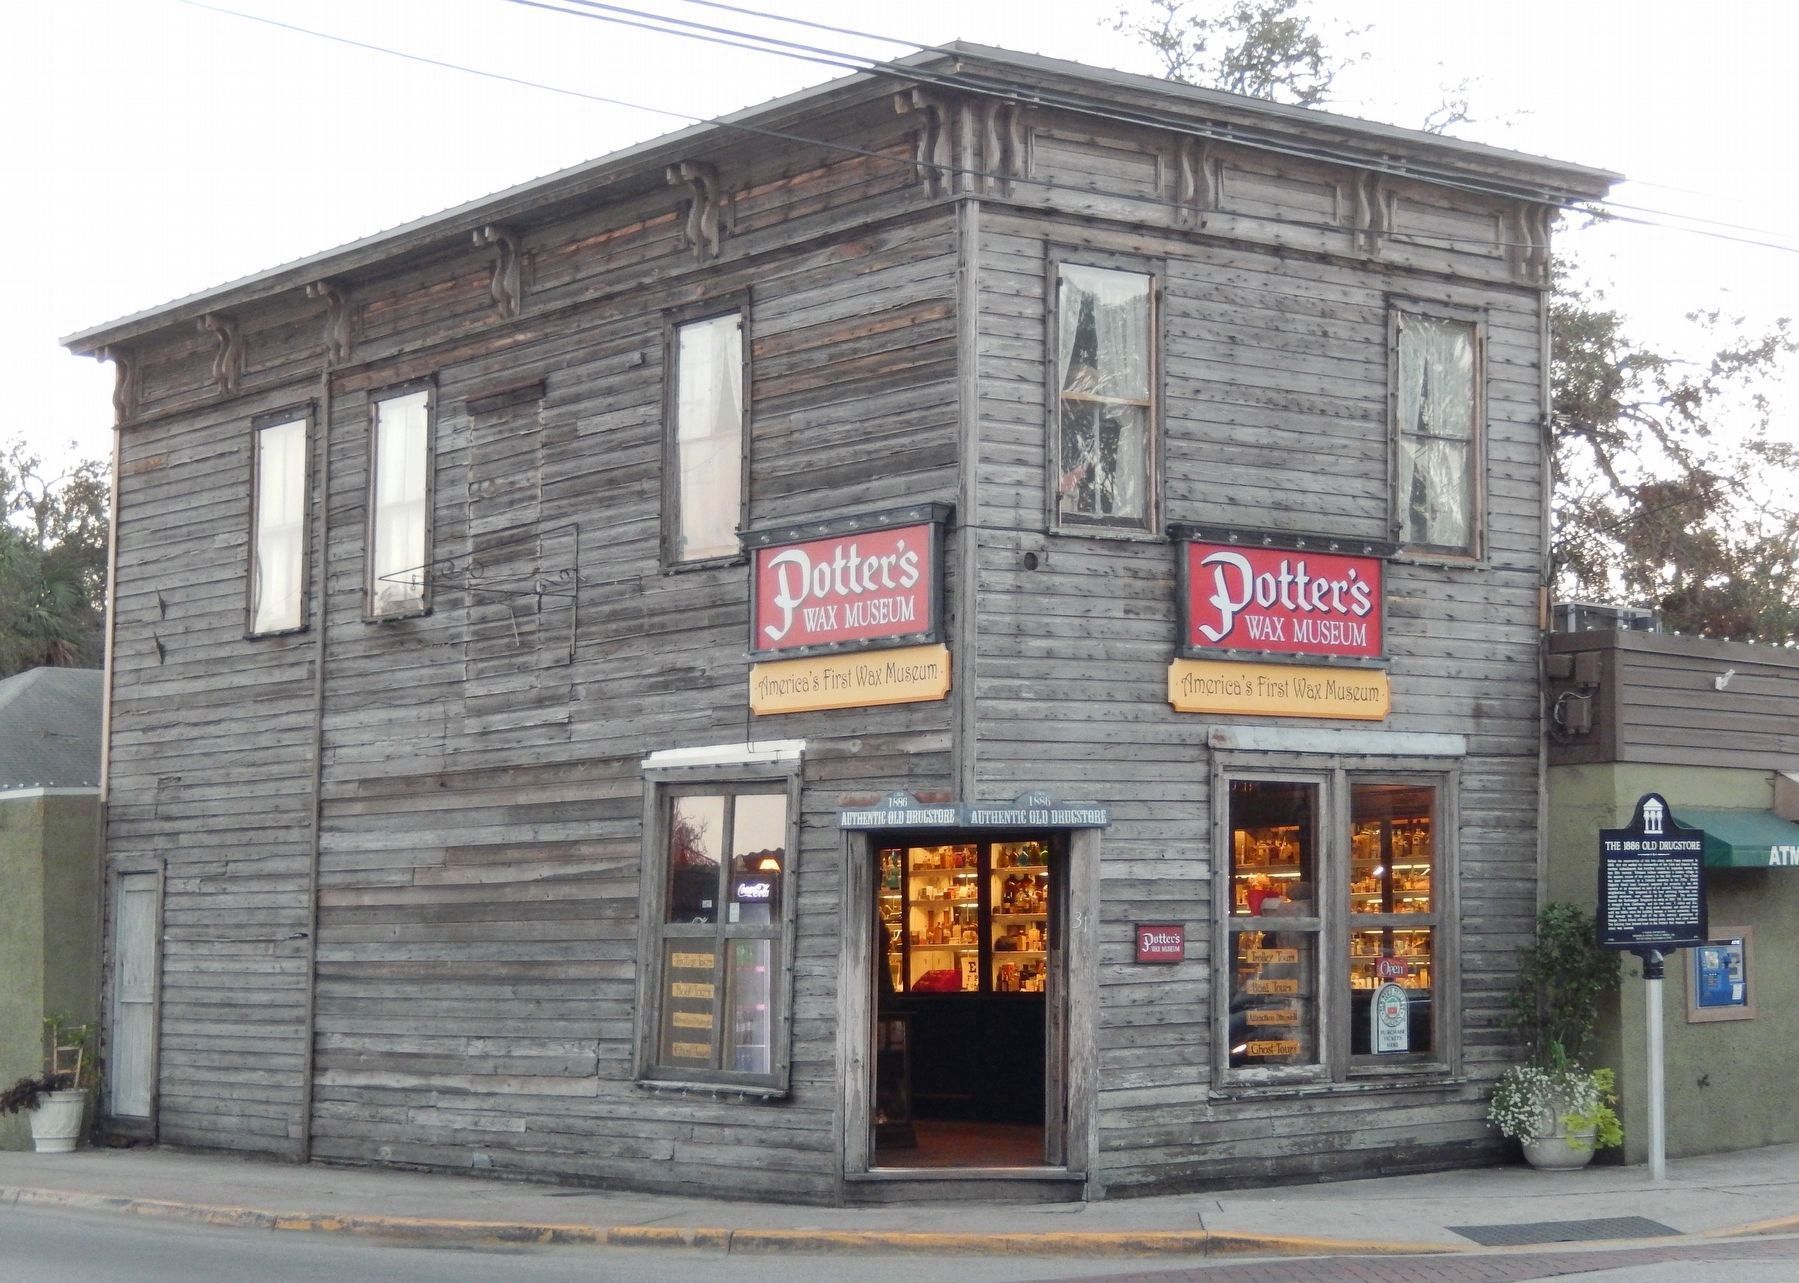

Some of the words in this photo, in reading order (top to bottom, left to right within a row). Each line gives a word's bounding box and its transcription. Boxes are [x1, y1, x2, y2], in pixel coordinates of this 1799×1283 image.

[764, 539, 920, 641] Potter's
[1198, 551, 1372, 642] Potter's
[803, 605, 838, 632] WAX
[845, 595, 915, 628] MUSEUM
[1245, 615, 1285, 641] WAX
[1292, 618, 1367, 646] MUSEUM
[758, 671, 820, 699] America's
[823, 668, 852, 690] First
[855, 665, 882, 687] Wax
[885, 662, 938, 683] Museum
[1181, 672, 1252, 697] America's
[1257, 675, 1289, 698] First
[1293, 678, 1322, 700] Wax
[1325, 680, 1379, 702] Museum
[888, 797, 908, 808] 1886
[1029, 795, 1051, 807] 1886
[841, 810, 886, 826] AUTHENTIC
[888, 811, 904, 825] OLD
[906, 809, 955, 824] DRUGSTORE
[971, 810, 1027, 824] AUTHENTIC
[1029, 810, 1048, 824] OLD
[1051, 810, 1107, 824] DRUGSTORE
[1605, 841, 1621, 851] THE
[1623, 841, 1640, 851] 1886
[1642, 841, 1657, 851] OLD
[1659, 841, 1701, 851] DRUGSTORE
[1142, 932, 1181, 952] Potter's
[1380, 960, 1404, 977] Open
